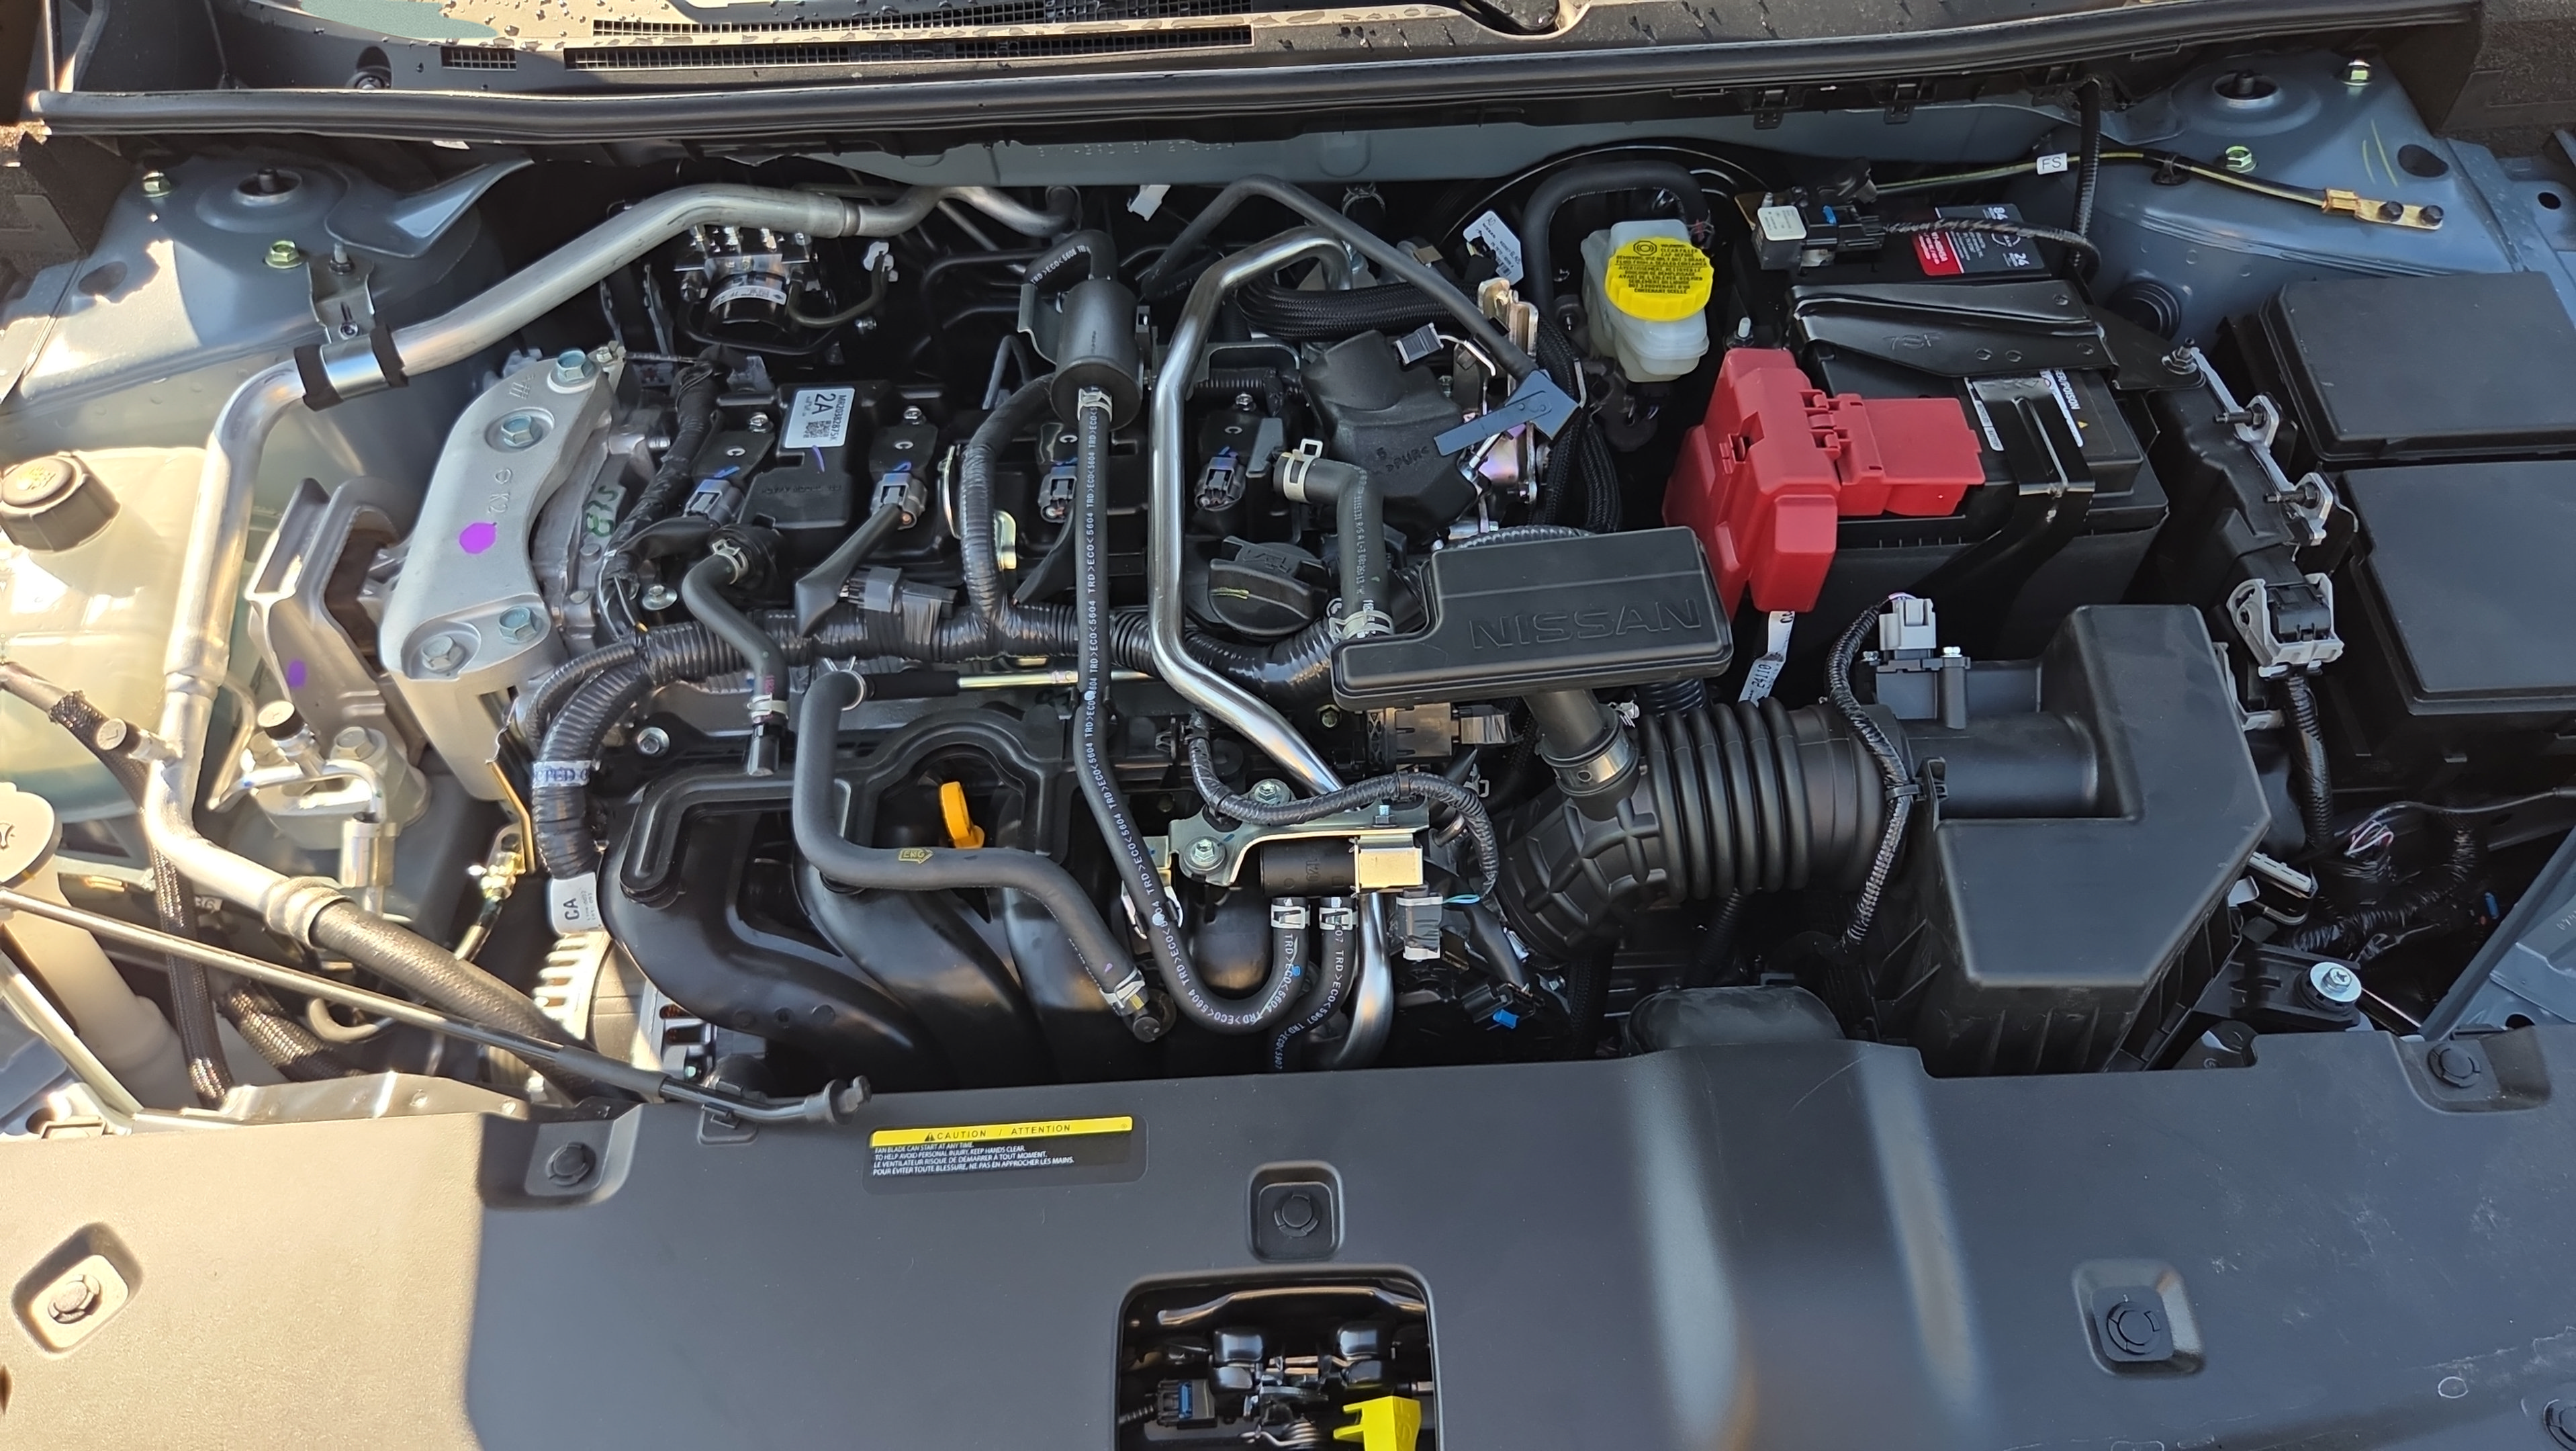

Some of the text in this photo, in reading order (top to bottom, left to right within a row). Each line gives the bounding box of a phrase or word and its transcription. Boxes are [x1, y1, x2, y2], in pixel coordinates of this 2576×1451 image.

[2042, 157, 2062, 170] FS
[812, 393, 836, 414] 2A
[1086, 513, 1096, 594] TRD>ECO<5604
[1471, 599, 1701, 649] NISSAN
[1088, 601, 1099, 673] TRD>ECO<5604
[1751, 664, 1772, 688] 24110
[563, 898, 580, 920] CA
[937, 1130, 986, 1139] CAUTION
[1011, 1125, 1070, 1135] ATTENTION
[882, 1159, 923, 1168] VENTILATEUR
[924, 1157, 947, 1166] RISQUE
[1017, 1151, 1047, 1159] MOMENT.
[918, 1150, 948, 1158] PERSONAL
[935, 1163, 968, 1172] BLESSURE,
[1001, 1159, 1039, 1168] APPROCHER
[1052, 1156, 1074, 1164] MAINS.
